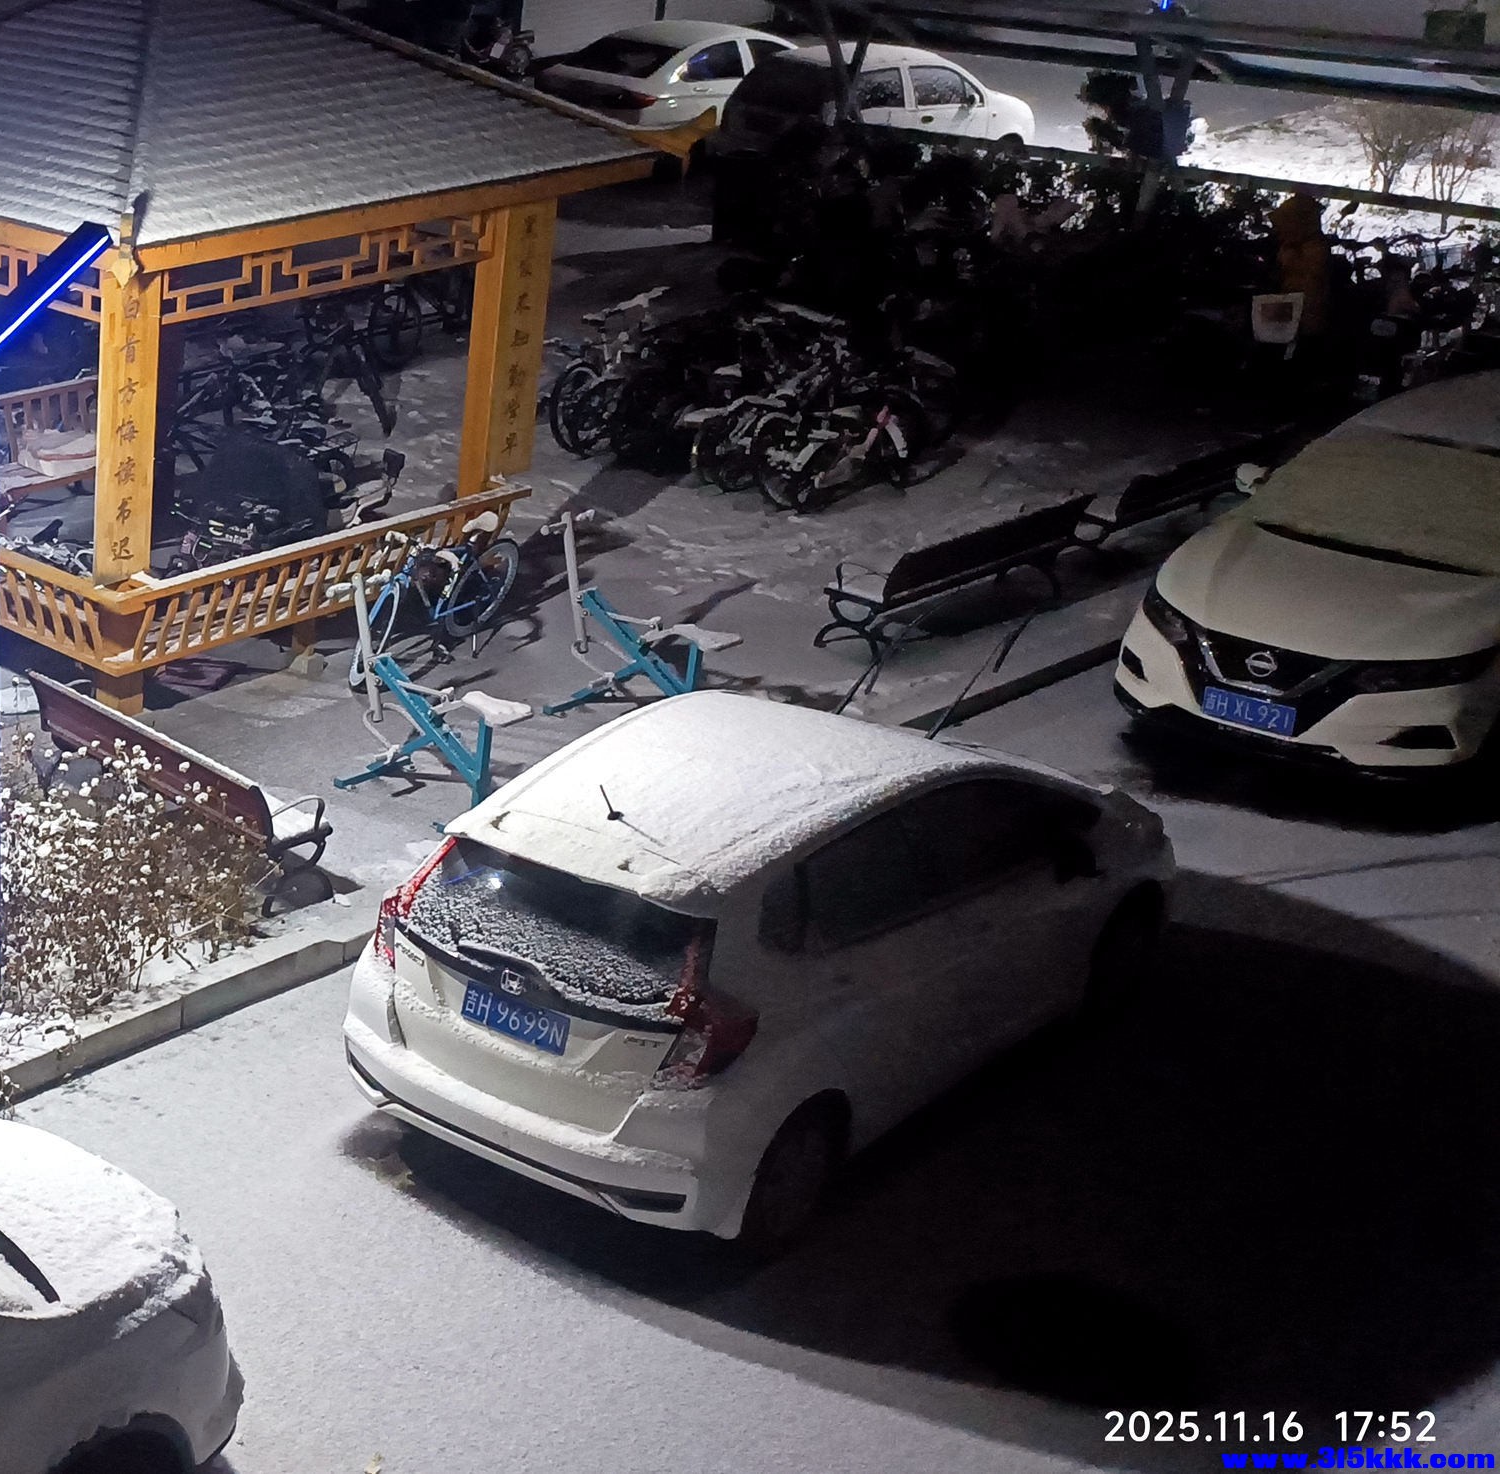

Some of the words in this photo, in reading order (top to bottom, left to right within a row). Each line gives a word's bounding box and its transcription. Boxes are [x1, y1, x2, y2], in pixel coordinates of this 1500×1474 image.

[111, 294, 141, 562] 白首方悔读书迟
